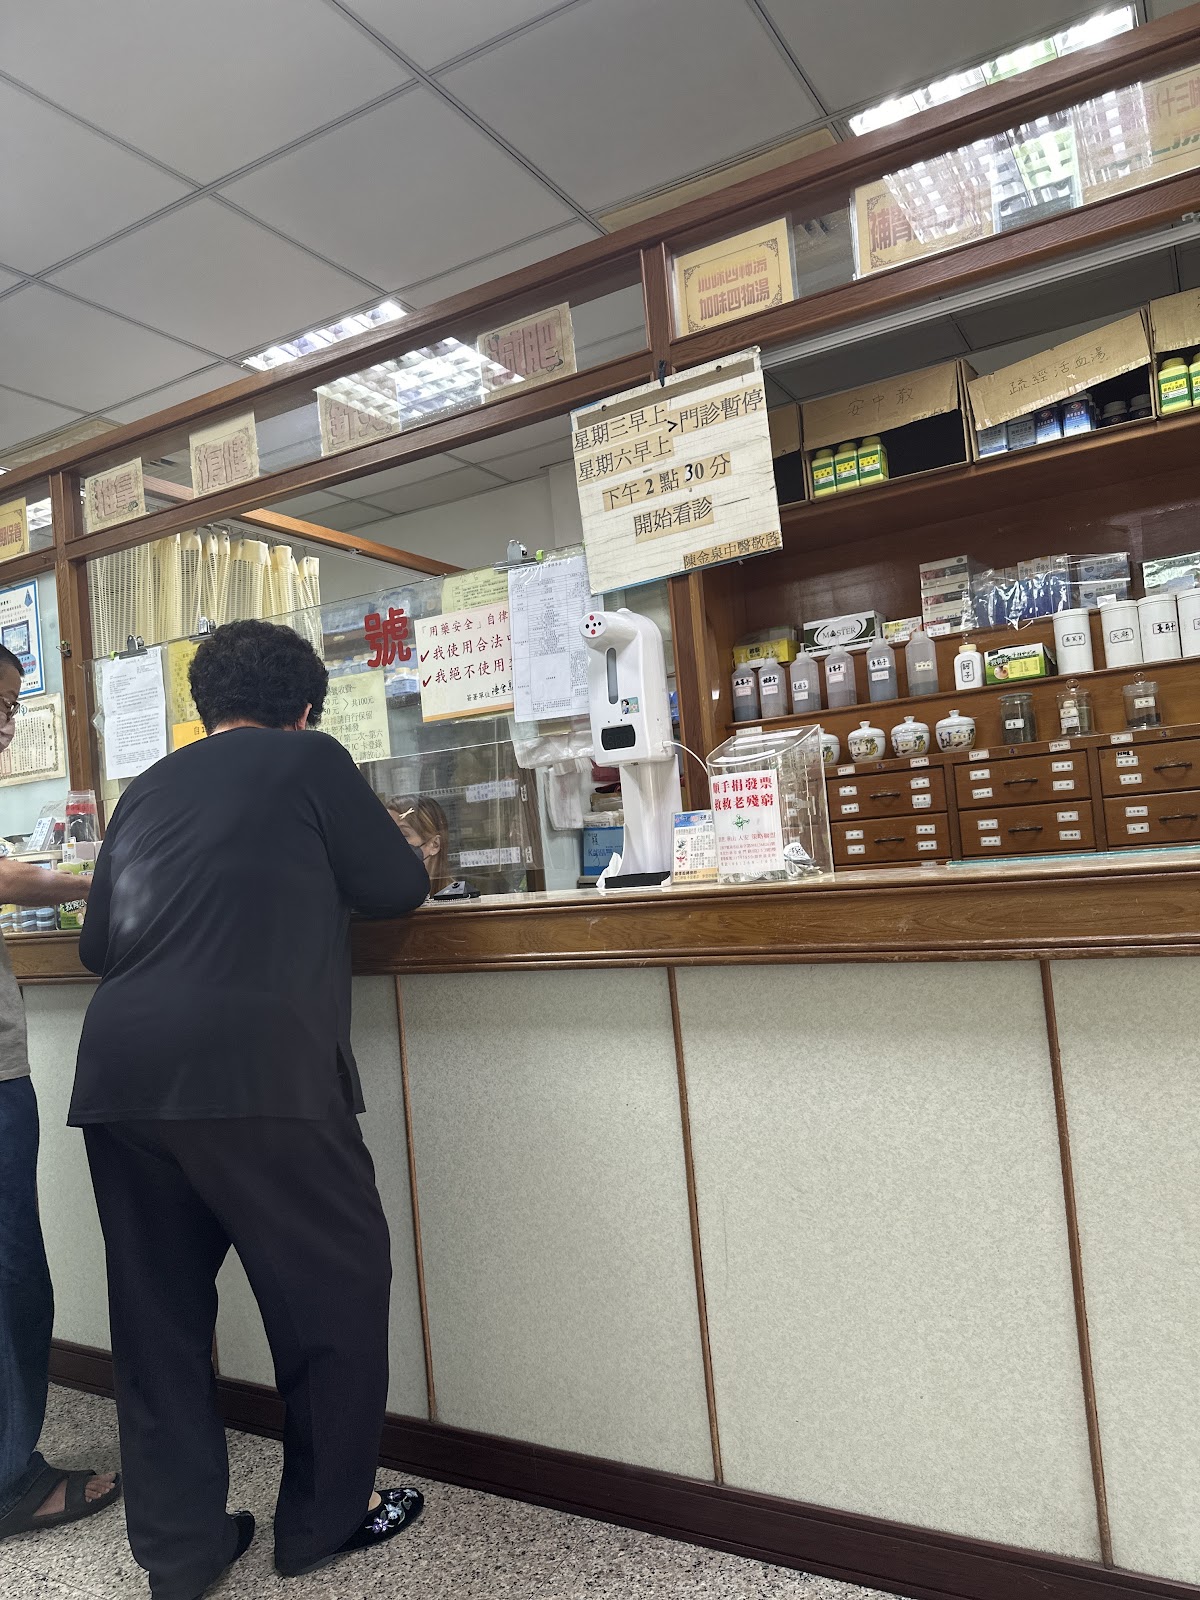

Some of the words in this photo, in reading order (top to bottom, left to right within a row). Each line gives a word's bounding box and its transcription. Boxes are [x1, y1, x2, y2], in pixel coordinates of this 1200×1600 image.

[699, 277, 770, 321] 加味四物湯
[574, 405, 668, 450] 星期三早上
[680, 389, 764, 432] 門診暫停
[578, 436, 672, 482] 星期六早上
[634, 496, 713, 537] 開始看診
[364, 607, 411, 668] 號
[321, 711, 372, 726] 收據請自行保留
[714, 793, 774, 811] 救救老殘窮
